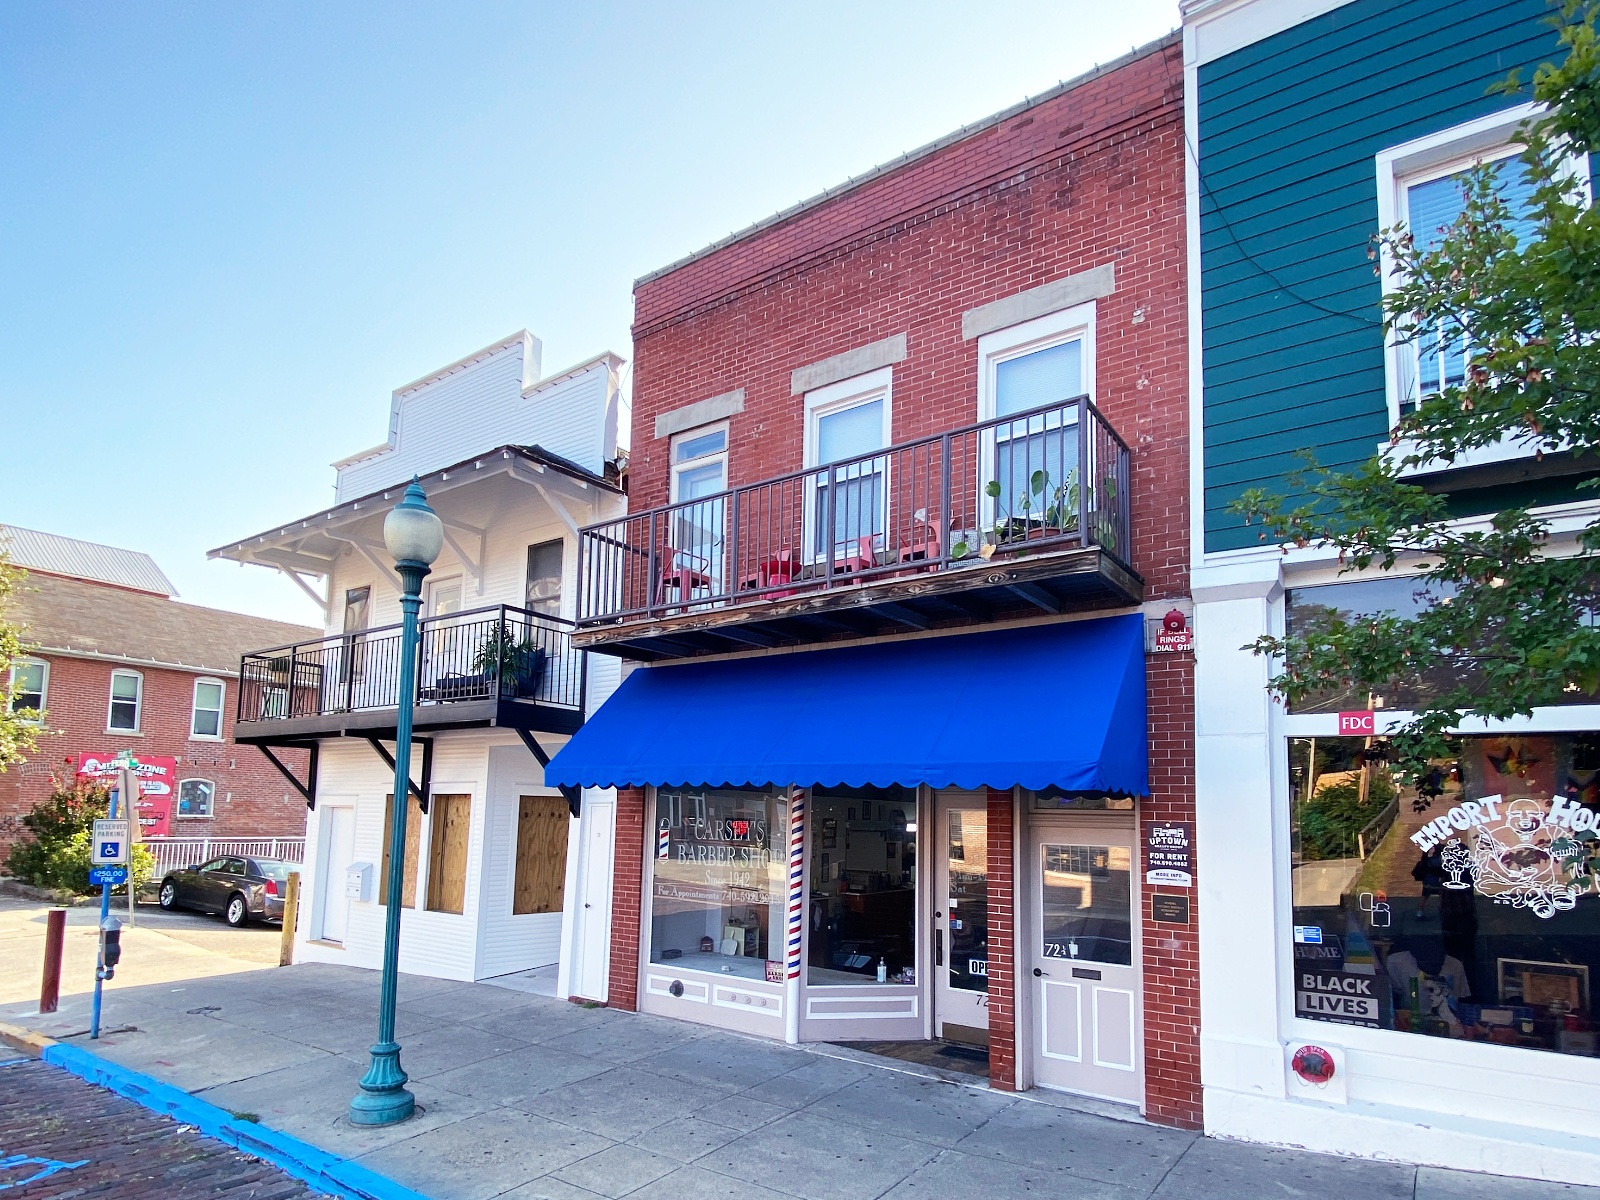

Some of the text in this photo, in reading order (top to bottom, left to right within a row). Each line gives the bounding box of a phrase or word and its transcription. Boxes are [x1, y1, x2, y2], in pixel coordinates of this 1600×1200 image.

[1160, 636, 1186, 644] RINGS
[1342, 716, 1372, 730] FDC
[137, 763, 167, 775] ZONE
[1410, 794, 1502, 853] IMPORT
[1149, 836, 1188, 847] UPTOWN
[677, 844, 785, 869] BARBER SHOP
[1149, 852, 1188, 861] FOR RENT
[729, 871, 750, 888] 1942
[658, 885, 669, 896] For
[671, 887, 720, 901] Appointments
[1303, 974, 1371, 995] BLACK
[1306, 995, 1369, 1015] LIVES
